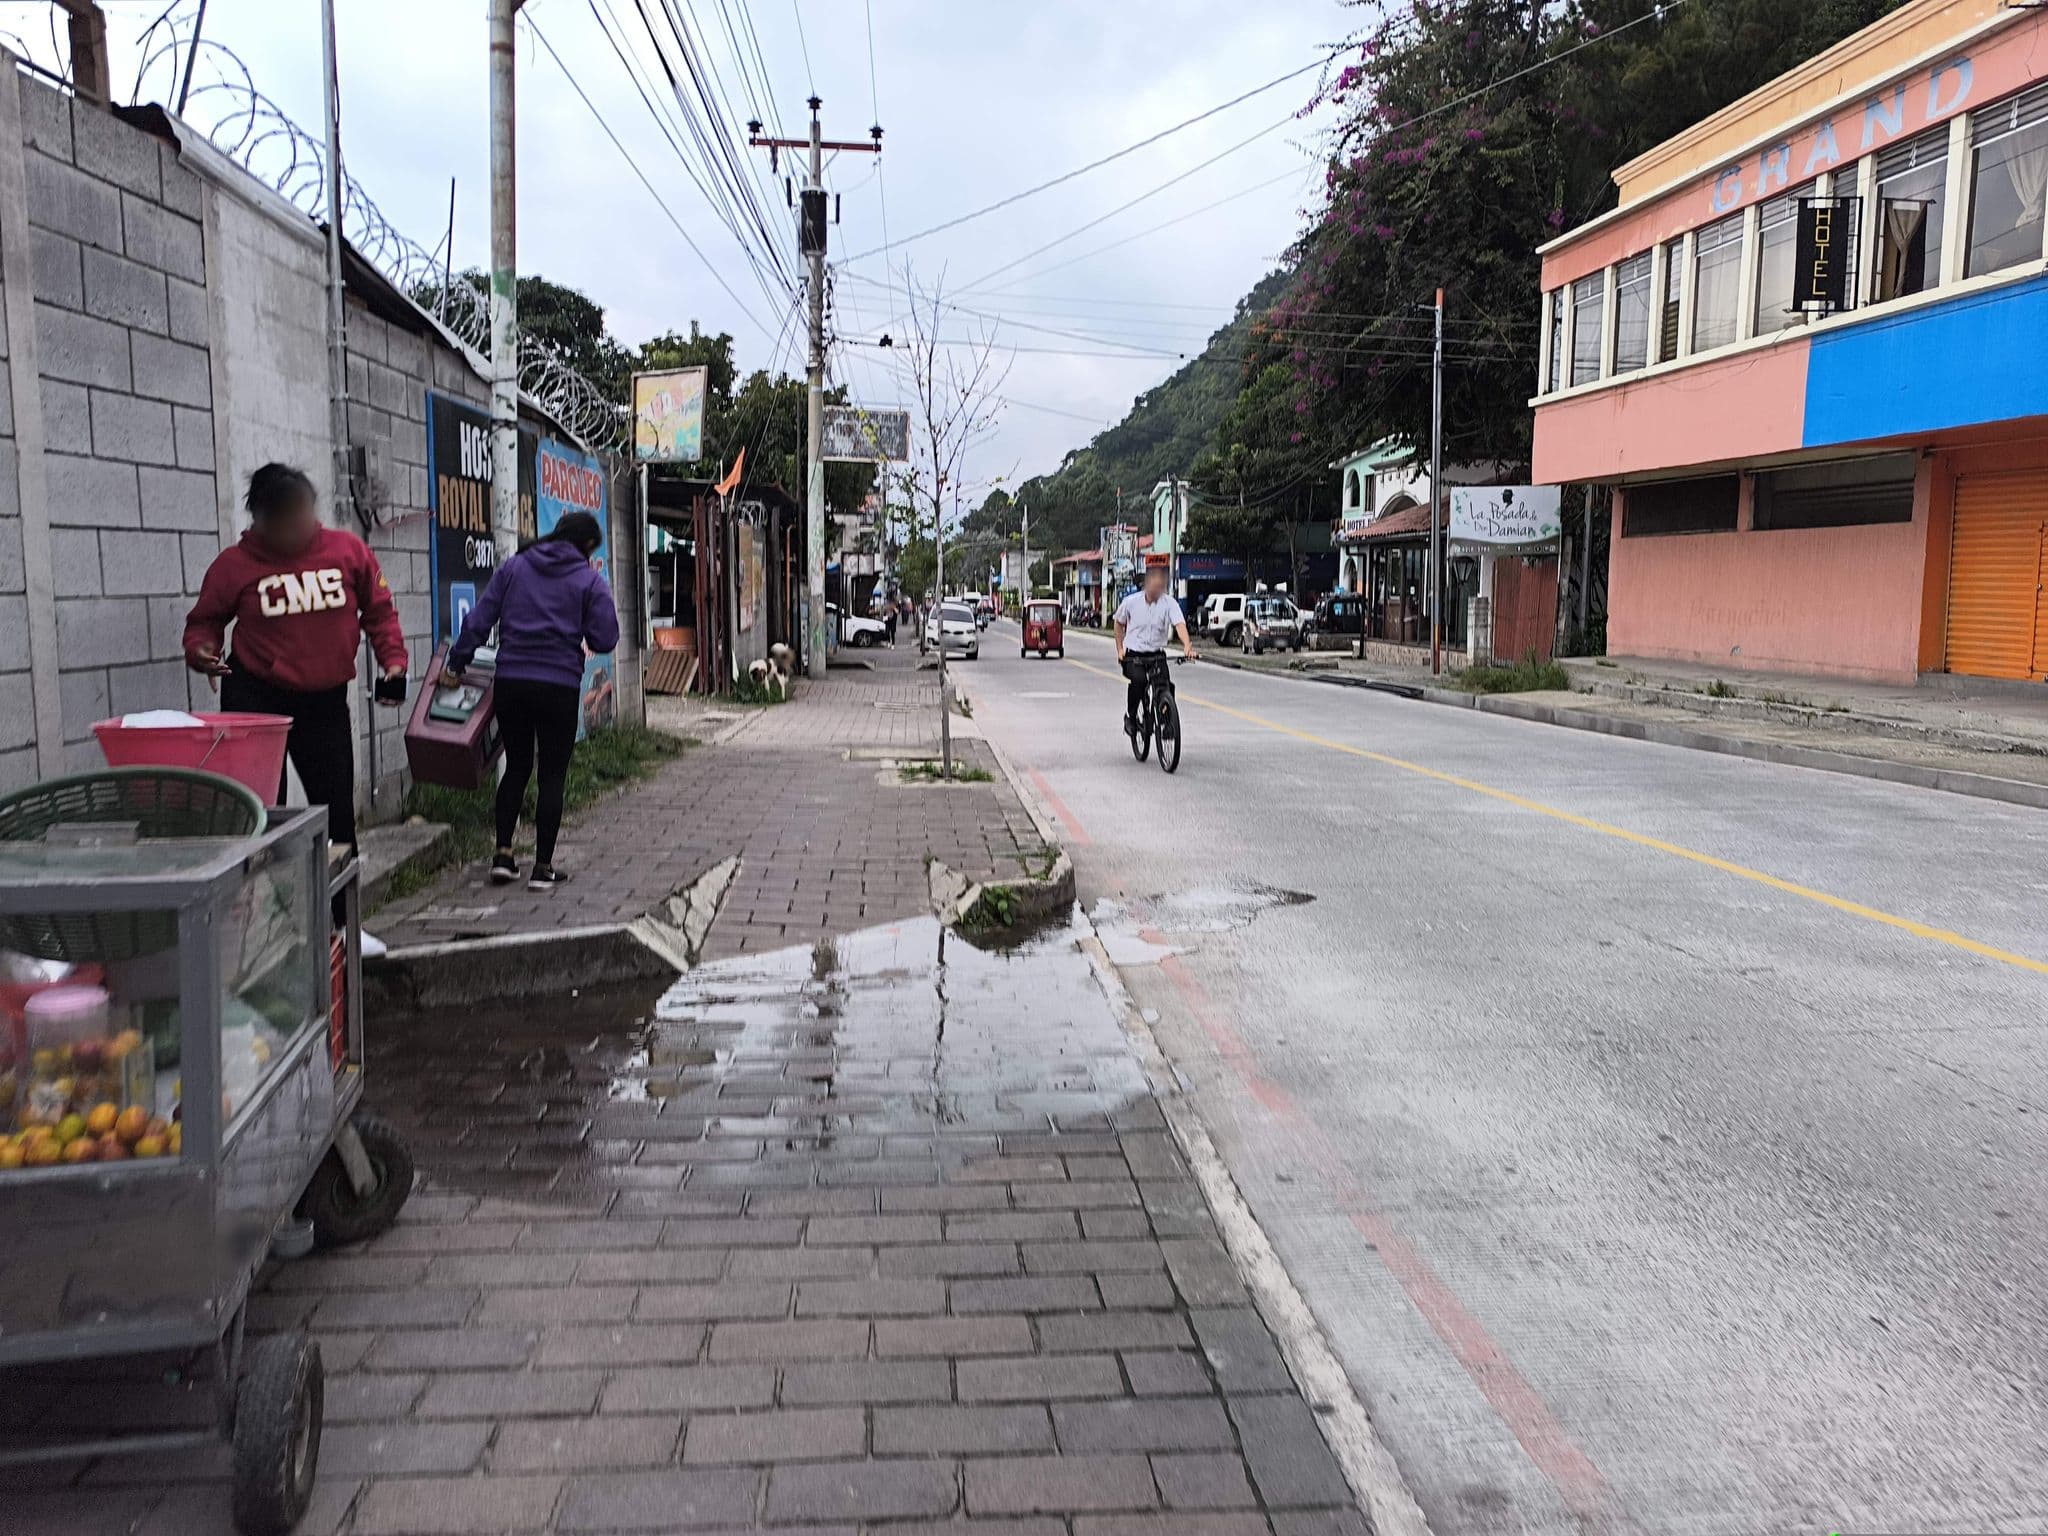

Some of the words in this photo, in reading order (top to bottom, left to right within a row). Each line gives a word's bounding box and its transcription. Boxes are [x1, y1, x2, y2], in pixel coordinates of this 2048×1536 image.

[1712, 56, 1974, 212] GRAND
[1812, 208, 1832, 296] HOTEL
[439, 472, 486, 533] ROYAL
[541, 450, 603, 512] PARQUEO
[1470, 501, 1484, 520] La
[1489, 500, 1528, 521] Posada
[257, 568, 347, 618] CMS
